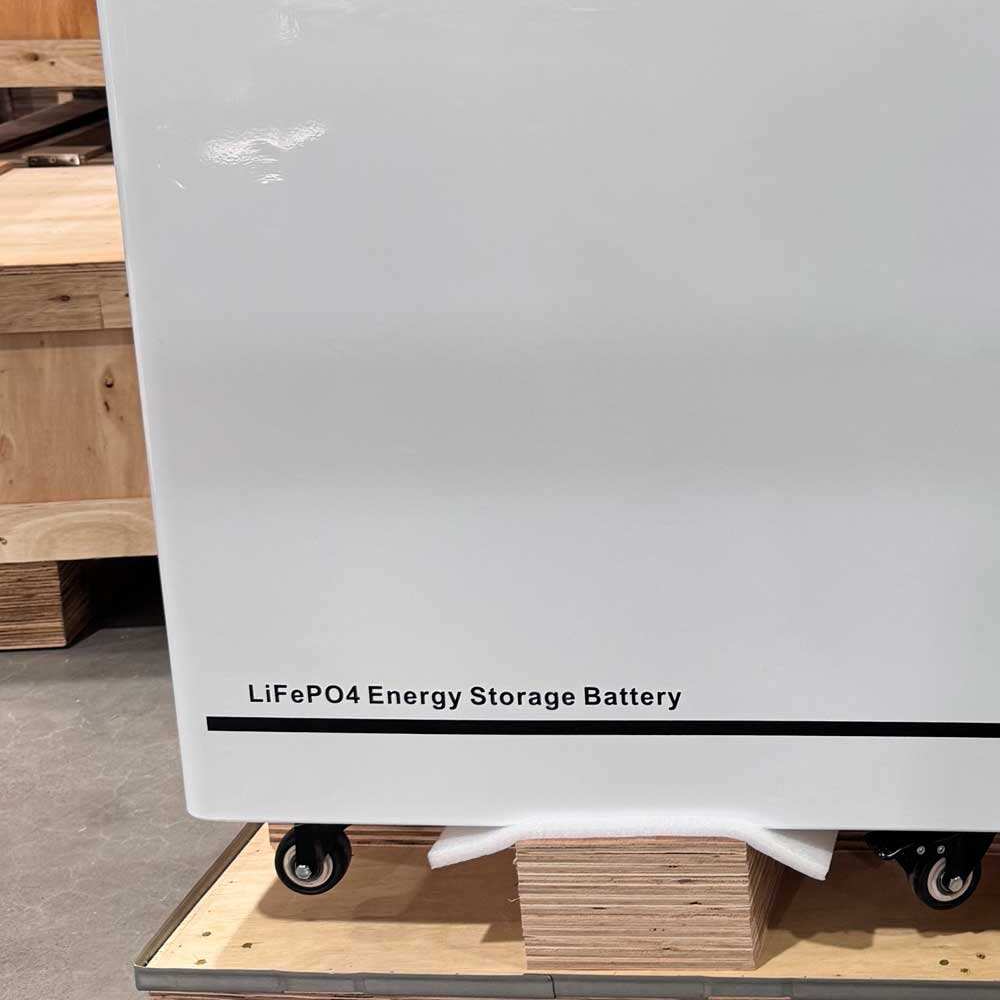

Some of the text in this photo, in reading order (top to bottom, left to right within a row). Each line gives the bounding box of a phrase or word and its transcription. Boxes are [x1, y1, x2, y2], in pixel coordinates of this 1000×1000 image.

[248, 684, 682, 711] LiFePO4 Energy Storage Battery
